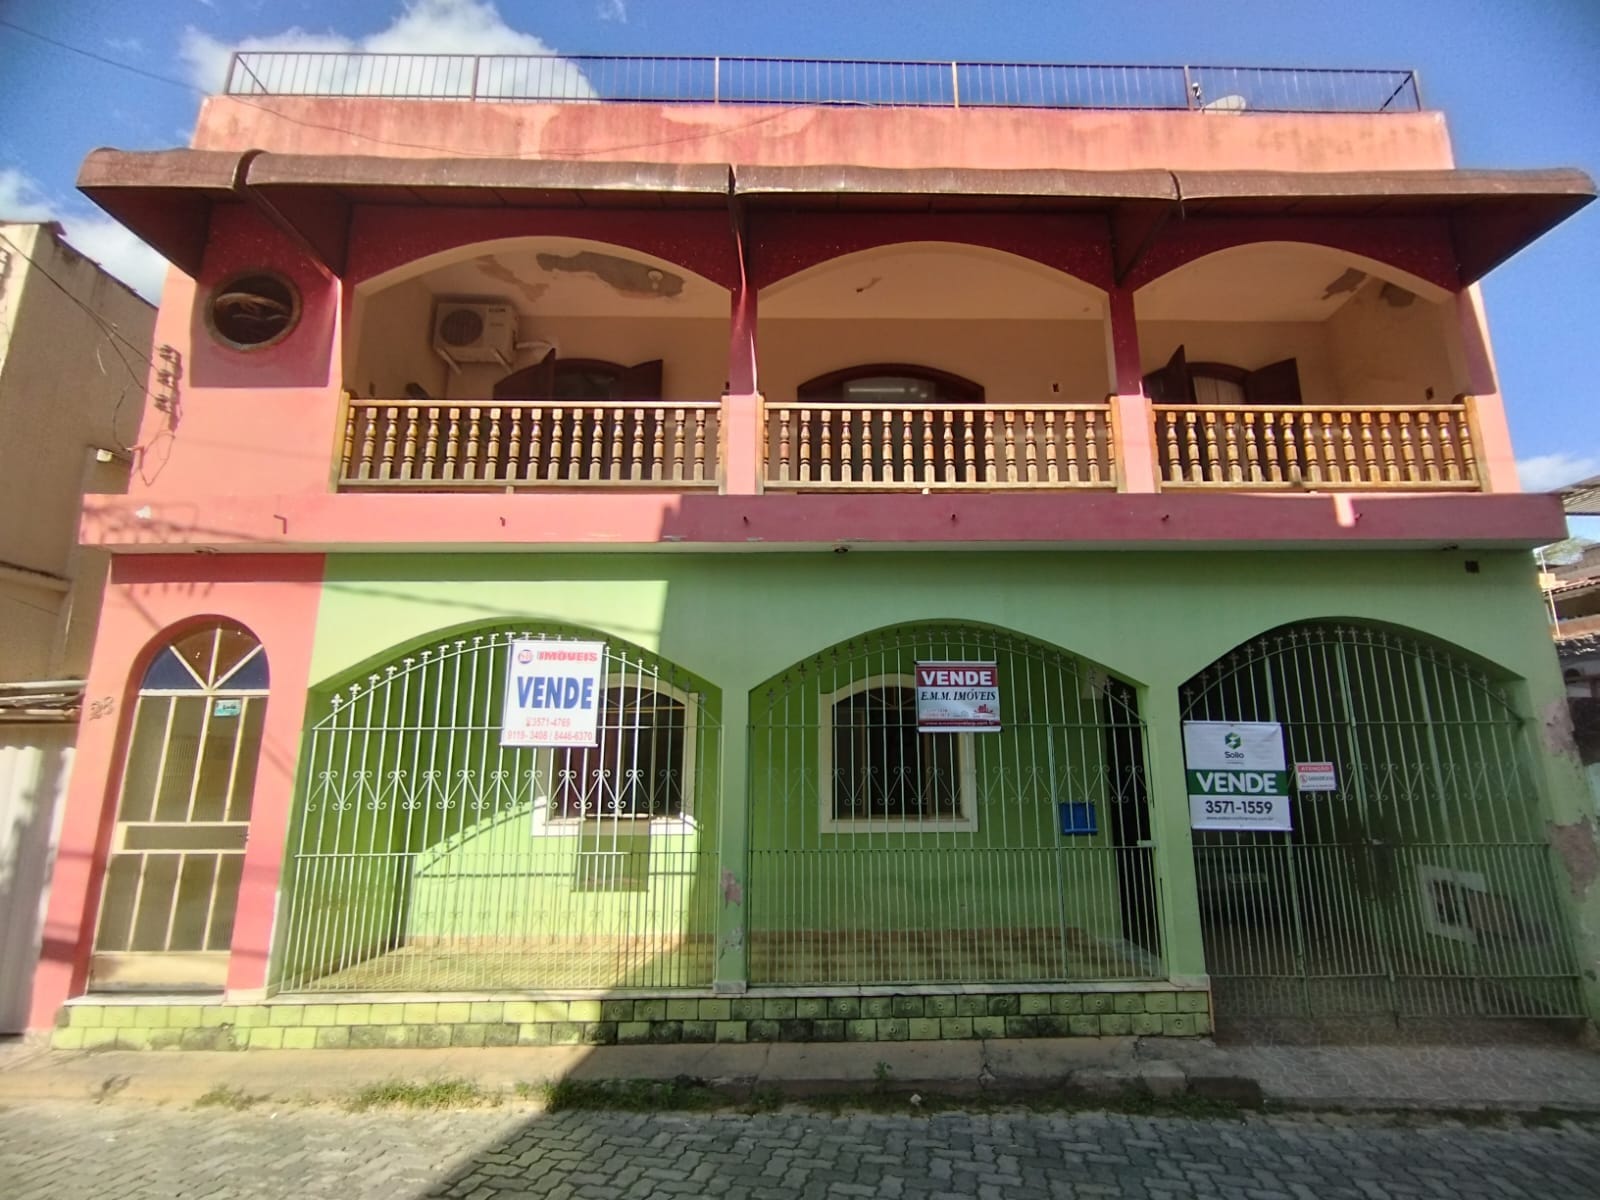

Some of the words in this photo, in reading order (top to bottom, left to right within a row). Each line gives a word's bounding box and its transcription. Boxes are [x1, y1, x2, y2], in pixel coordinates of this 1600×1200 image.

[921, 671, 992, 685] VENDE
[517, 676, 594, 709] VENDE
[921, 691, 951, 700] E.M.M.
[953, 688, 996, 700] IMÓVEIS
[1195, 772, 1278, 793] VENDE
[1205, 800, 1273, 814] 3571-1559
